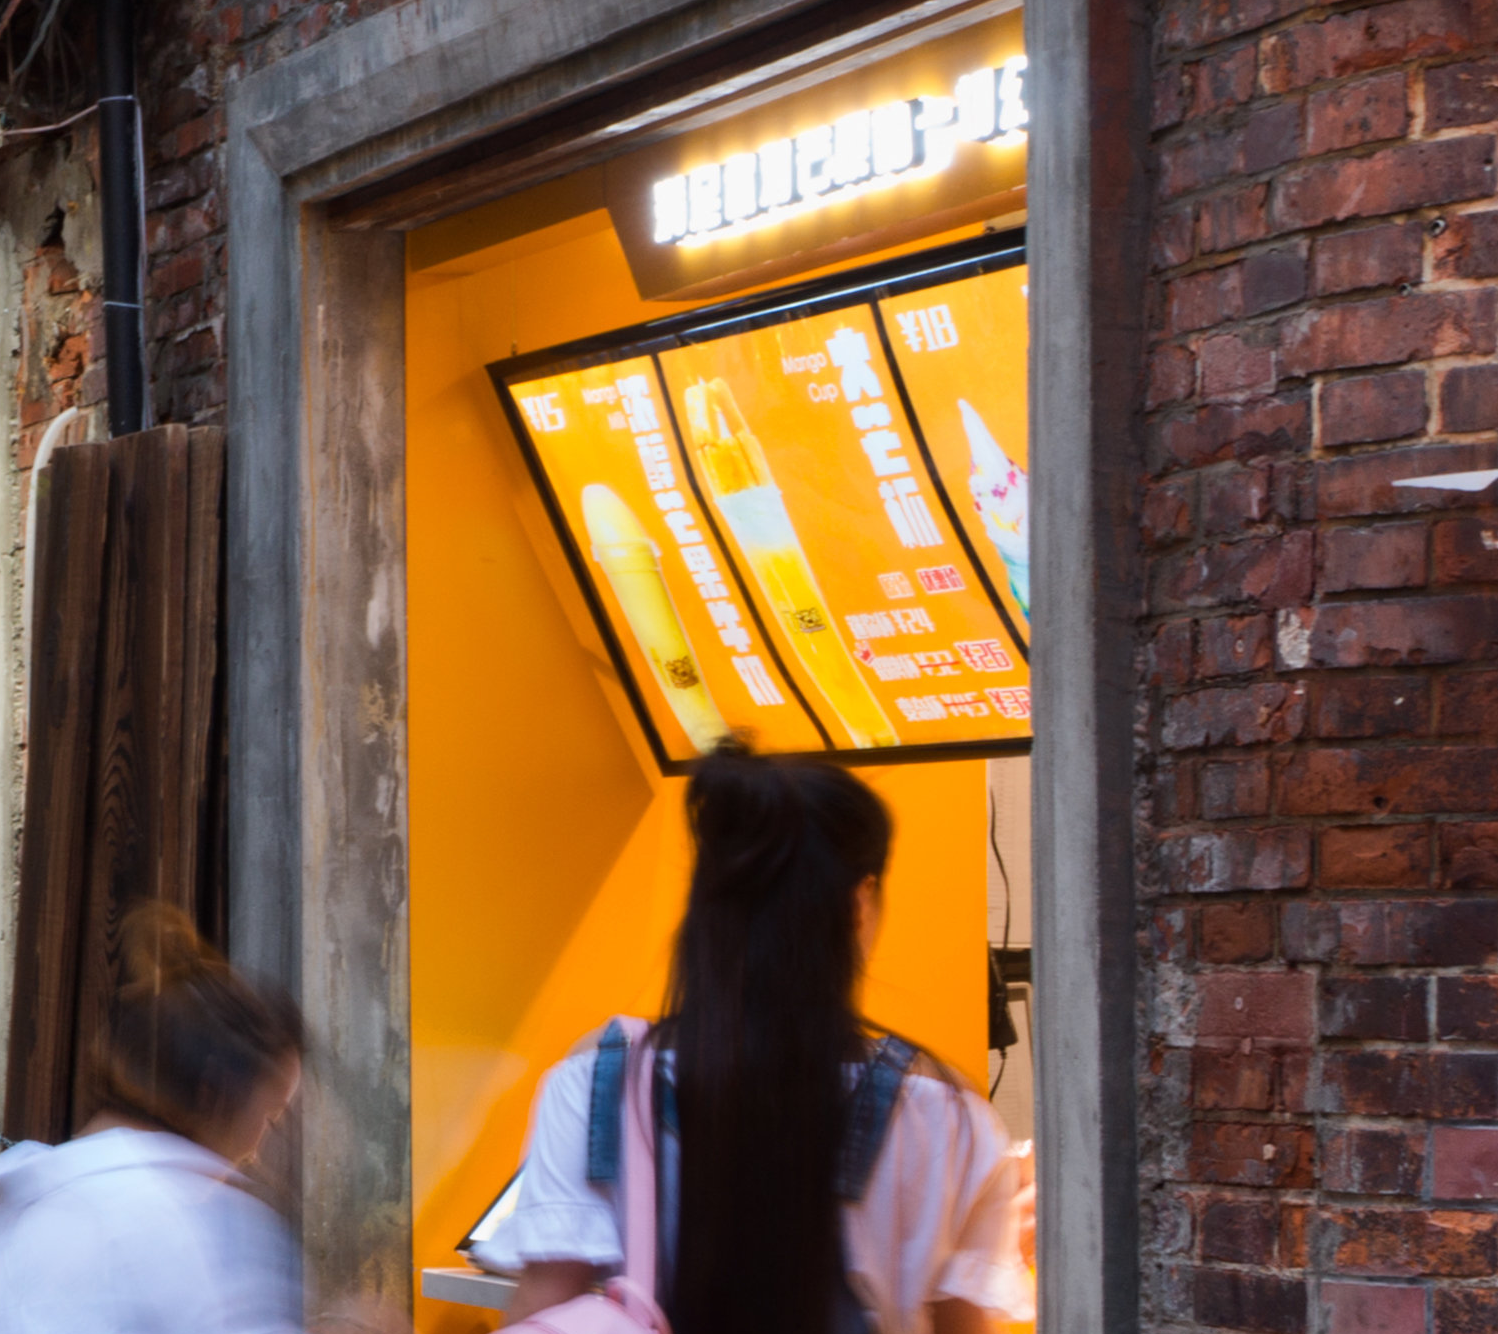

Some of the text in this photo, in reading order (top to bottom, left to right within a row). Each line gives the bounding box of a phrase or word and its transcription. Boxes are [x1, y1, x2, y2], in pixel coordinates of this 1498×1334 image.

[895, 303, 960, 352] ¥18
[781, 350, 827, 376] Mango
[808, 380, 839, 405] Cup
[519, 392, 567, 433] ¥15
